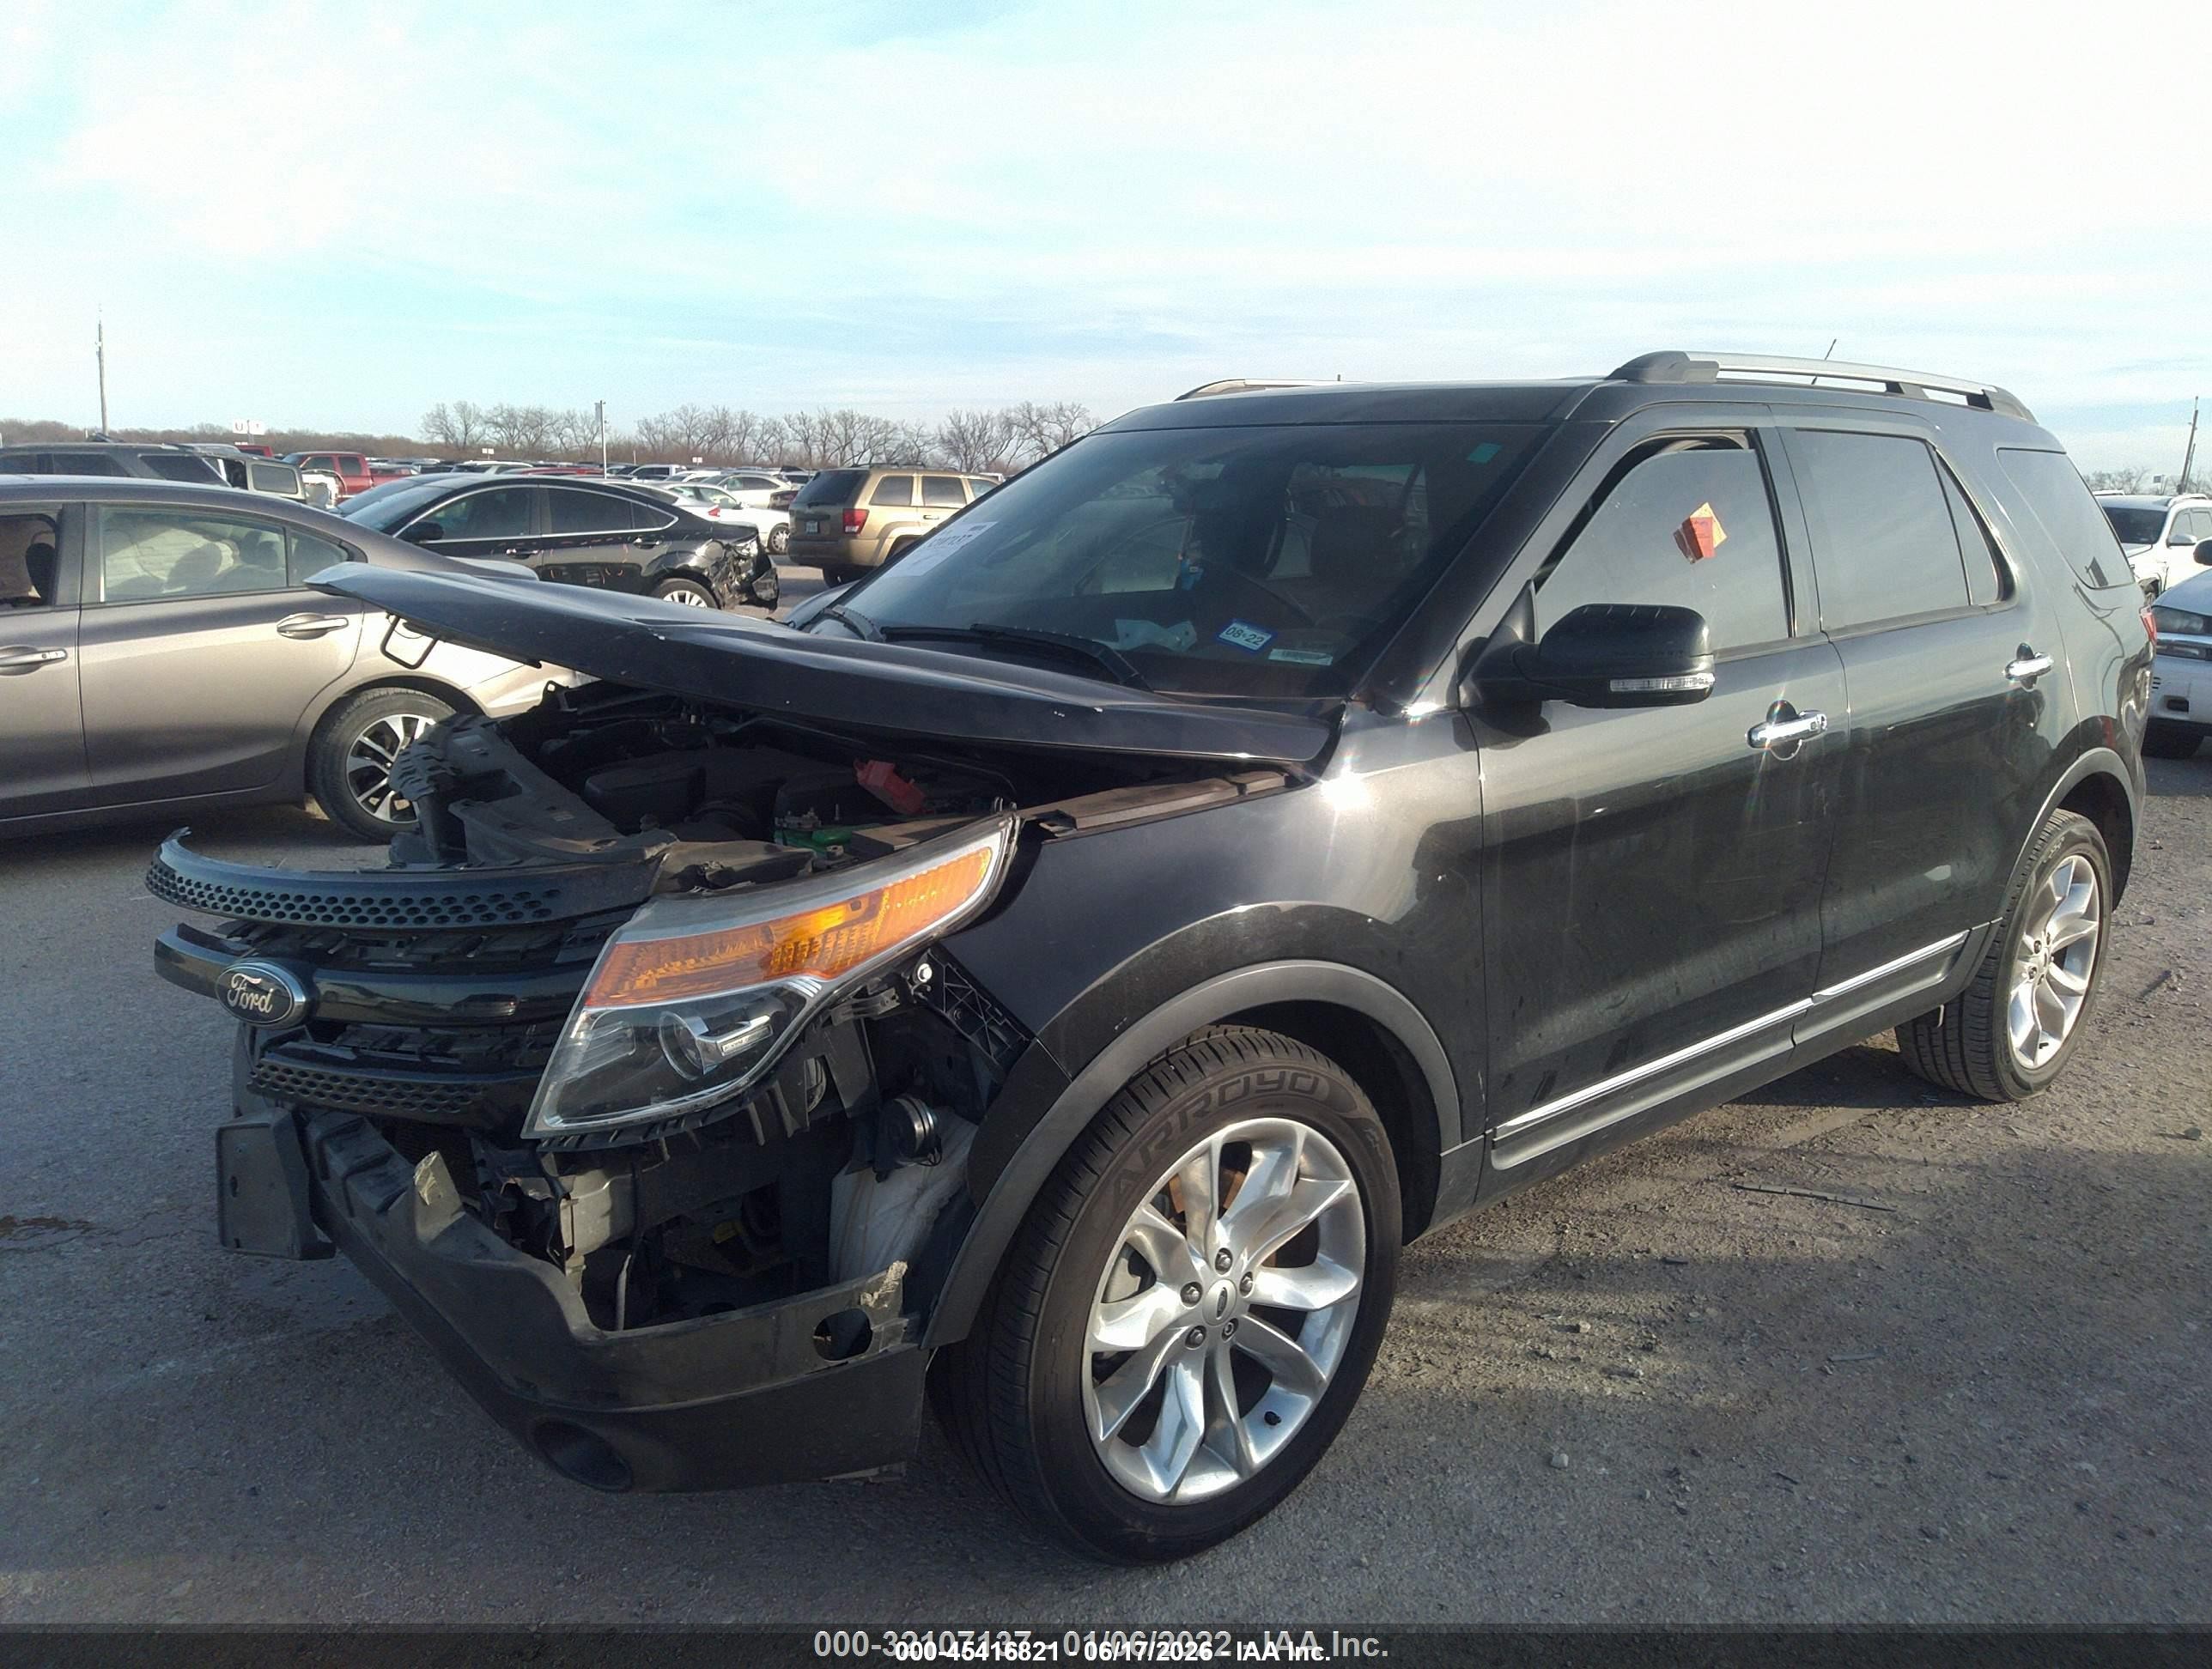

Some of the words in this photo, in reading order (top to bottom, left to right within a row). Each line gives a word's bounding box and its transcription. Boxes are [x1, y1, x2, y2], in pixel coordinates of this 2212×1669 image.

[1225, 627, 1244, 638] 08
[1244, 634, 1265, 646] 22
[227, 973, 274, 1013] Ford
[1116, 1071, 1321, 1195] ARROYO
